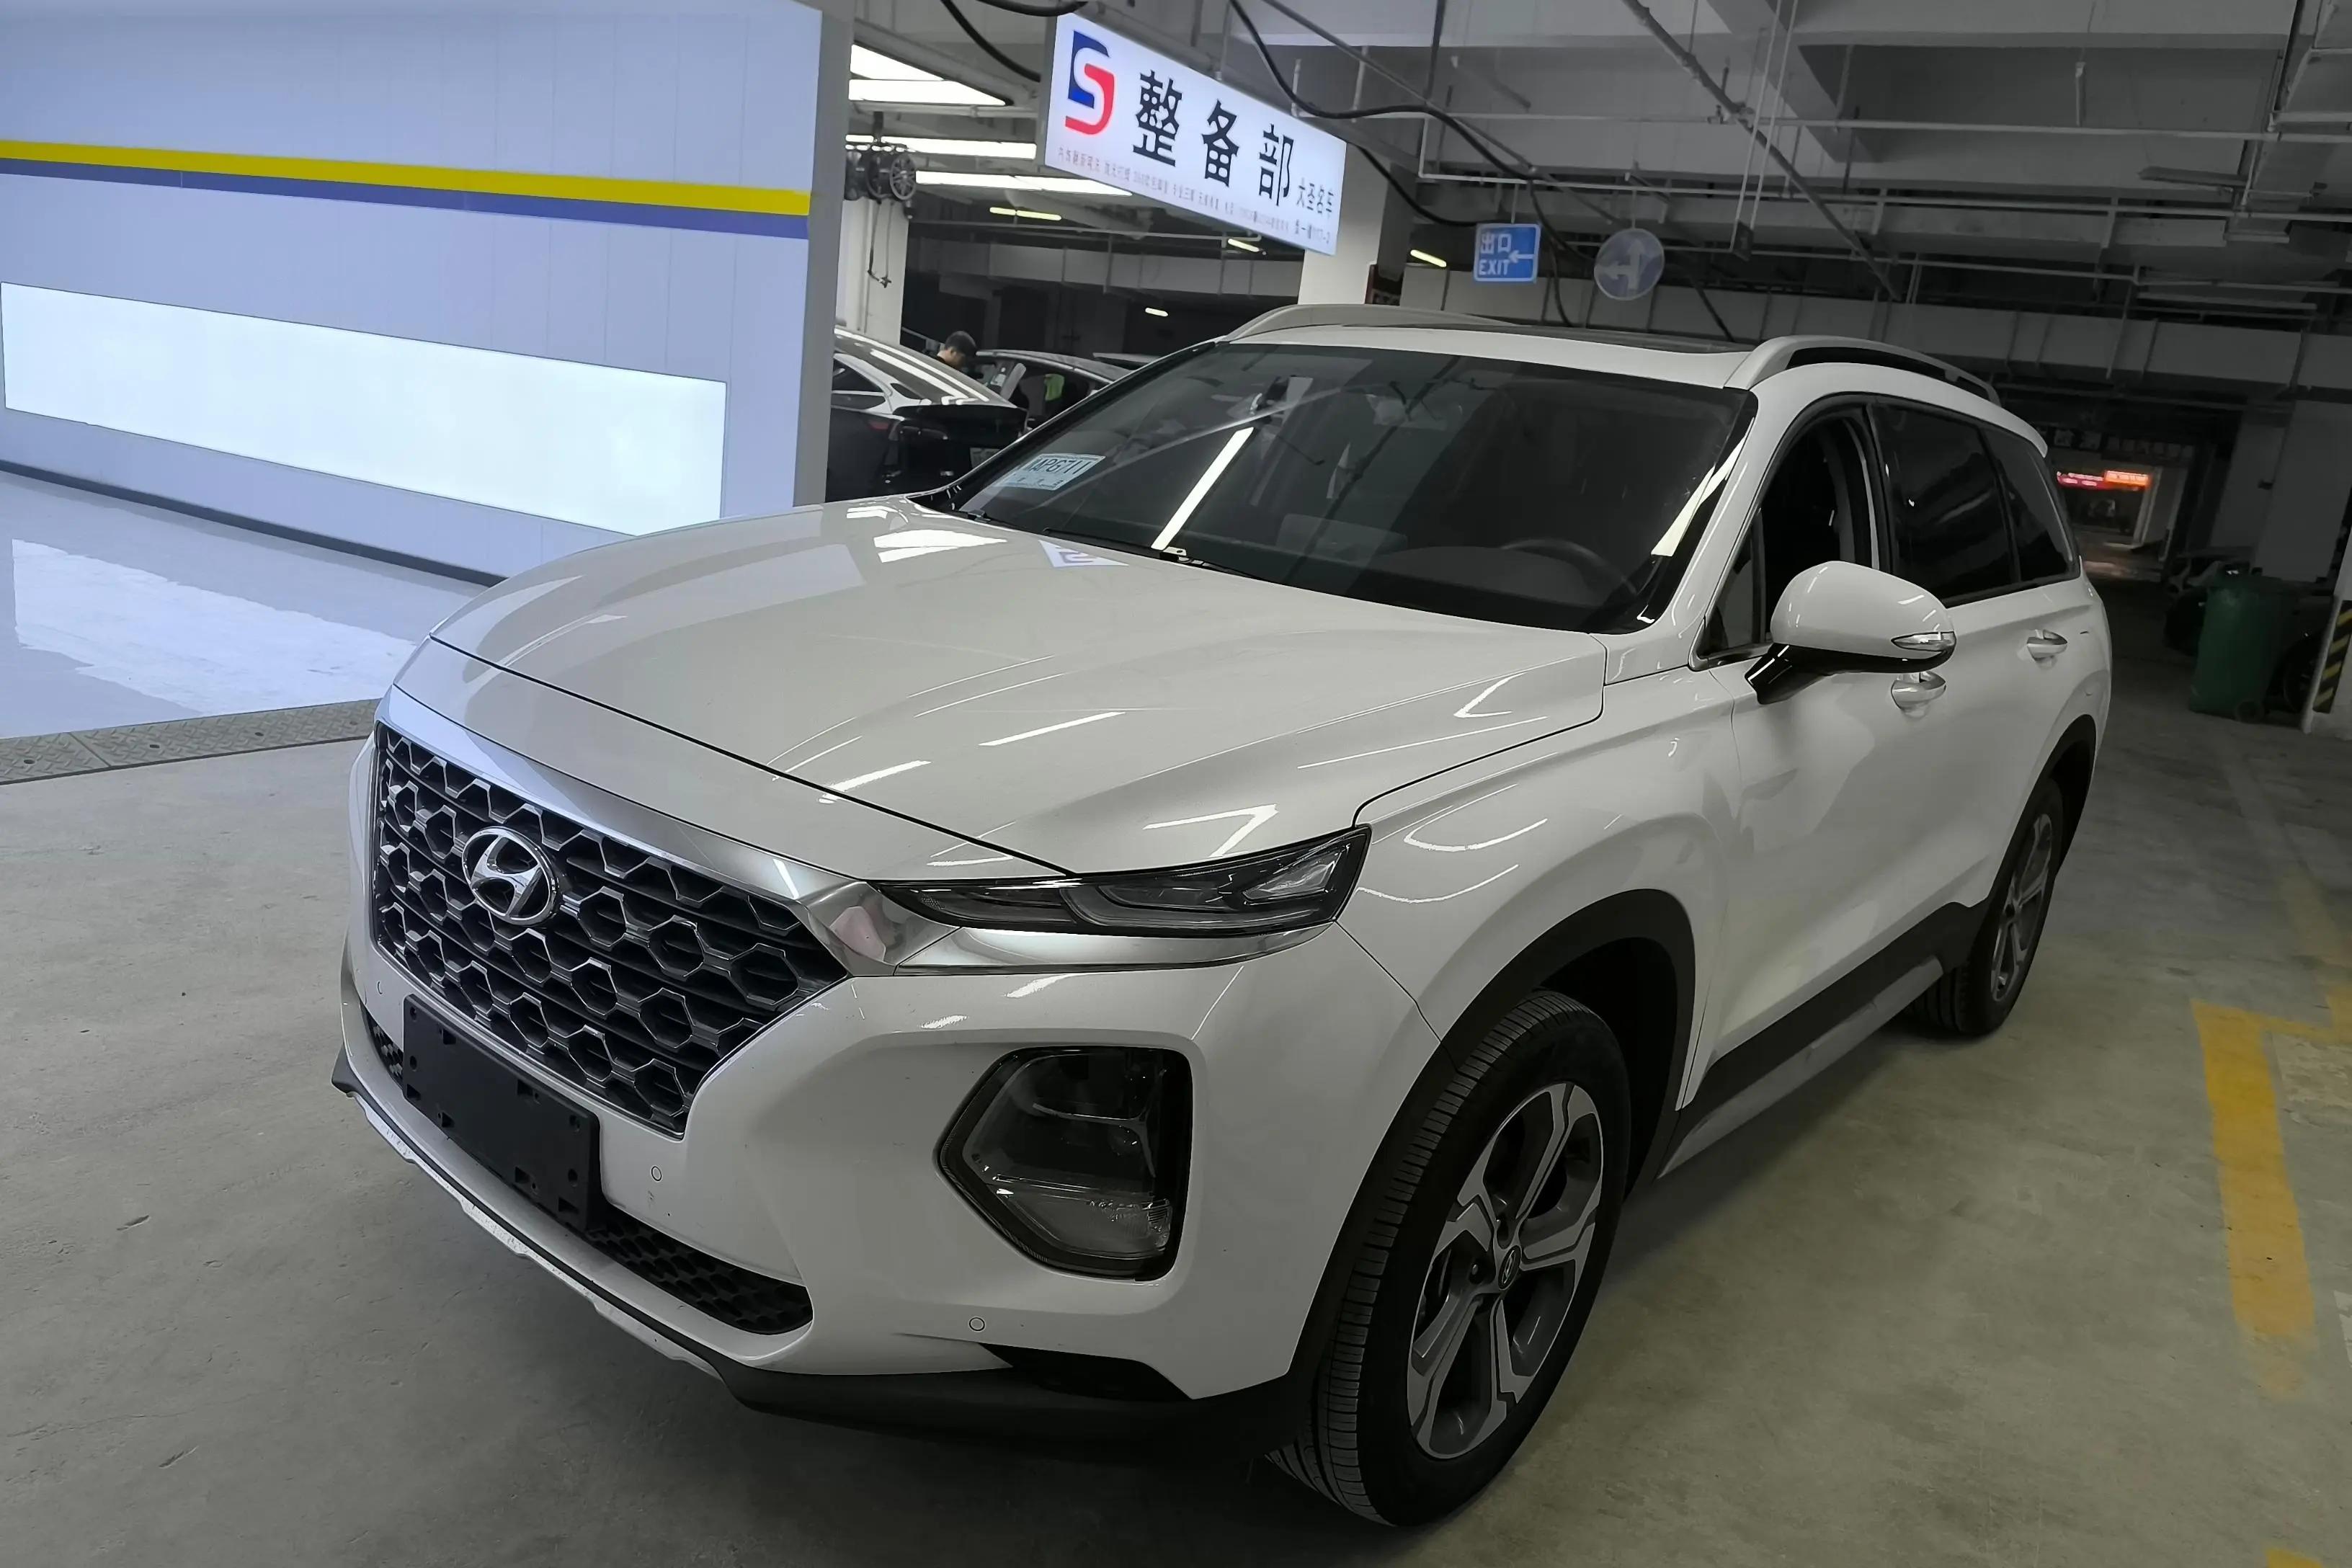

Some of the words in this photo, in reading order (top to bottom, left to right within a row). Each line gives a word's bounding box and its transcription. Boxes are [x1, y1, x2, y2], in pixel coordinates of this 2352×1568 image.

[1133, 70, 1294, 206] 整备部
[1479, 232, 1512, 254] 出口
[1479, 259, 1510, 275] EXIT
